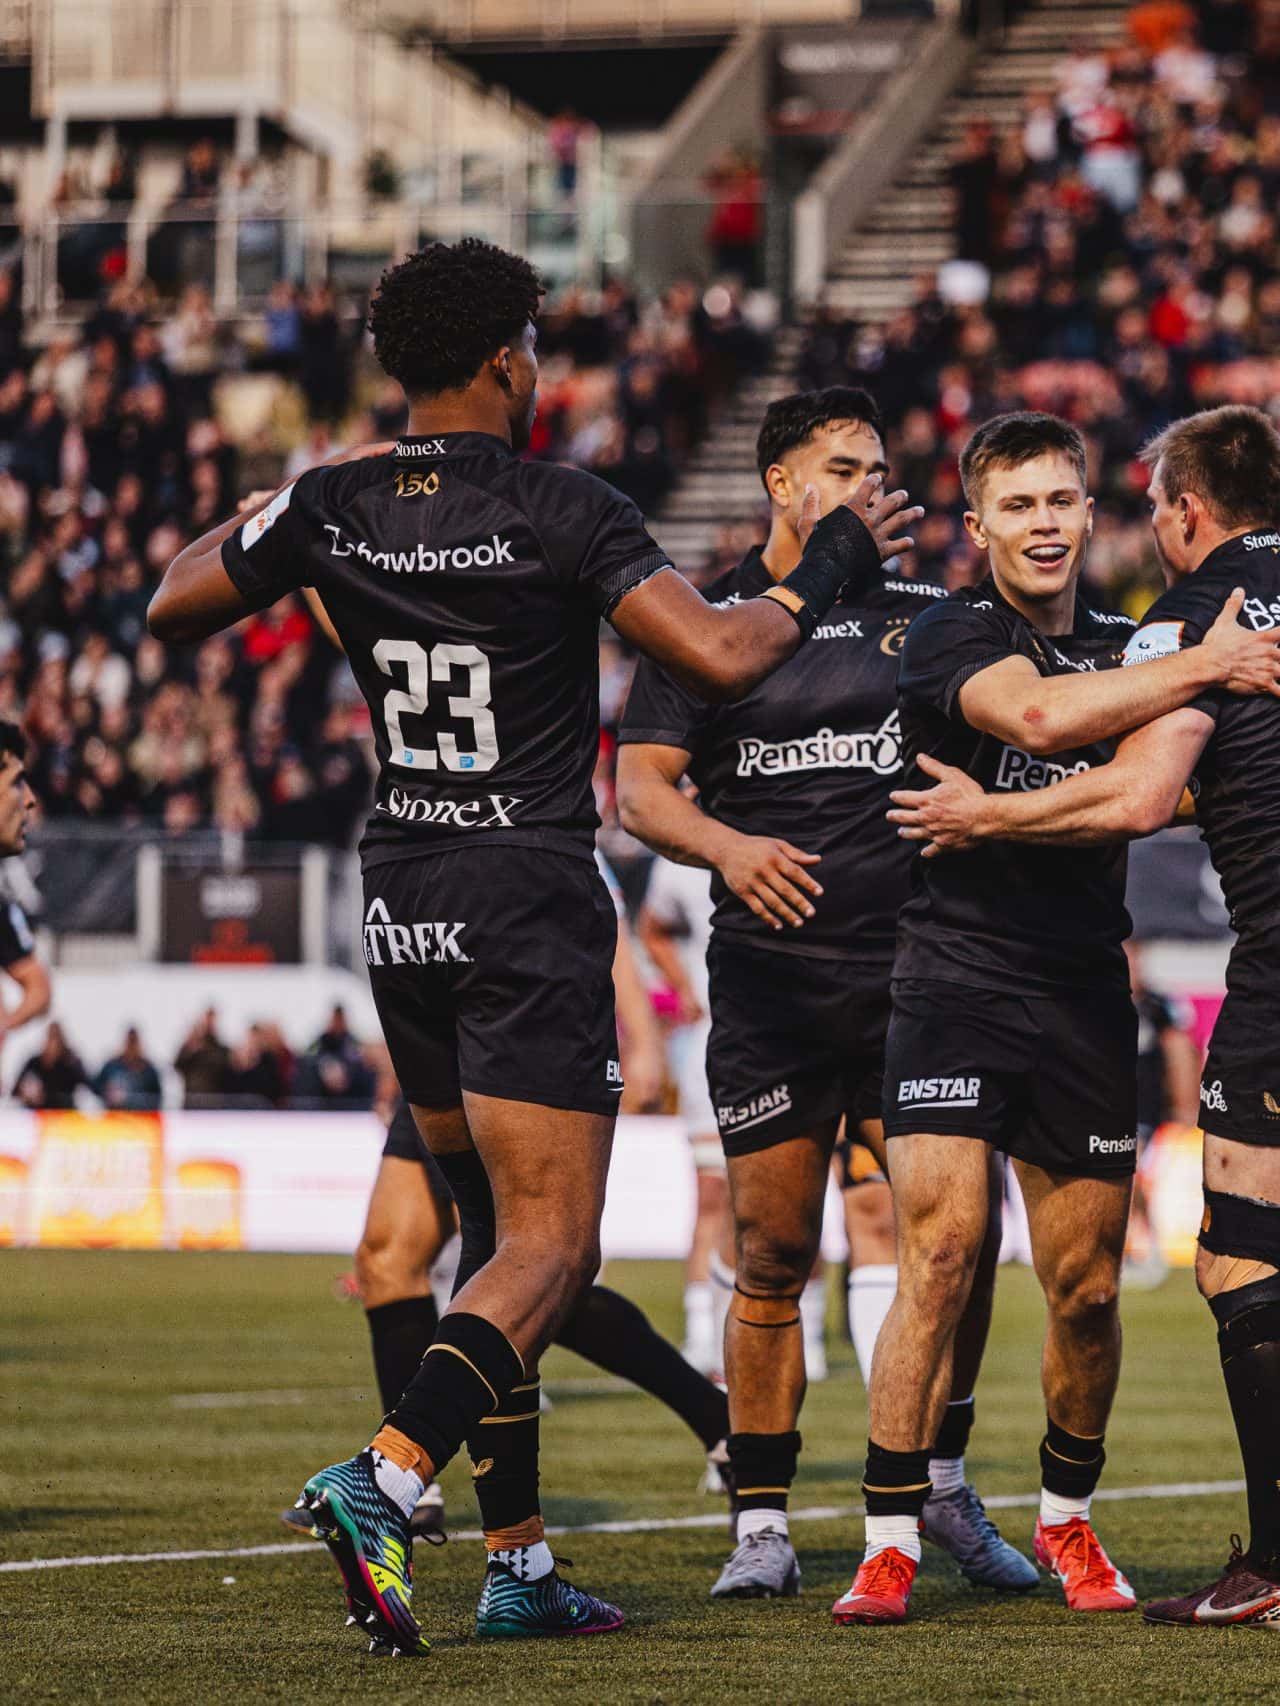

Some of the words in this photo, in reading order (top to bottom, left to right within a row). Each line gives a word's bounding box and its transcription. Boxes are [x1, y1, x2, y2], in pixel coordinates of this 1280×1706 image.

[394, 472, 440, 497] 150
[348, 535, 515, 573] hawbrook
[373, 638, 499, 772] 23
[376, 788, 524, 827] StoneX
[363, 922, 470, 967] TREK
[897, 1077, 981, 1102] ENSTAR
